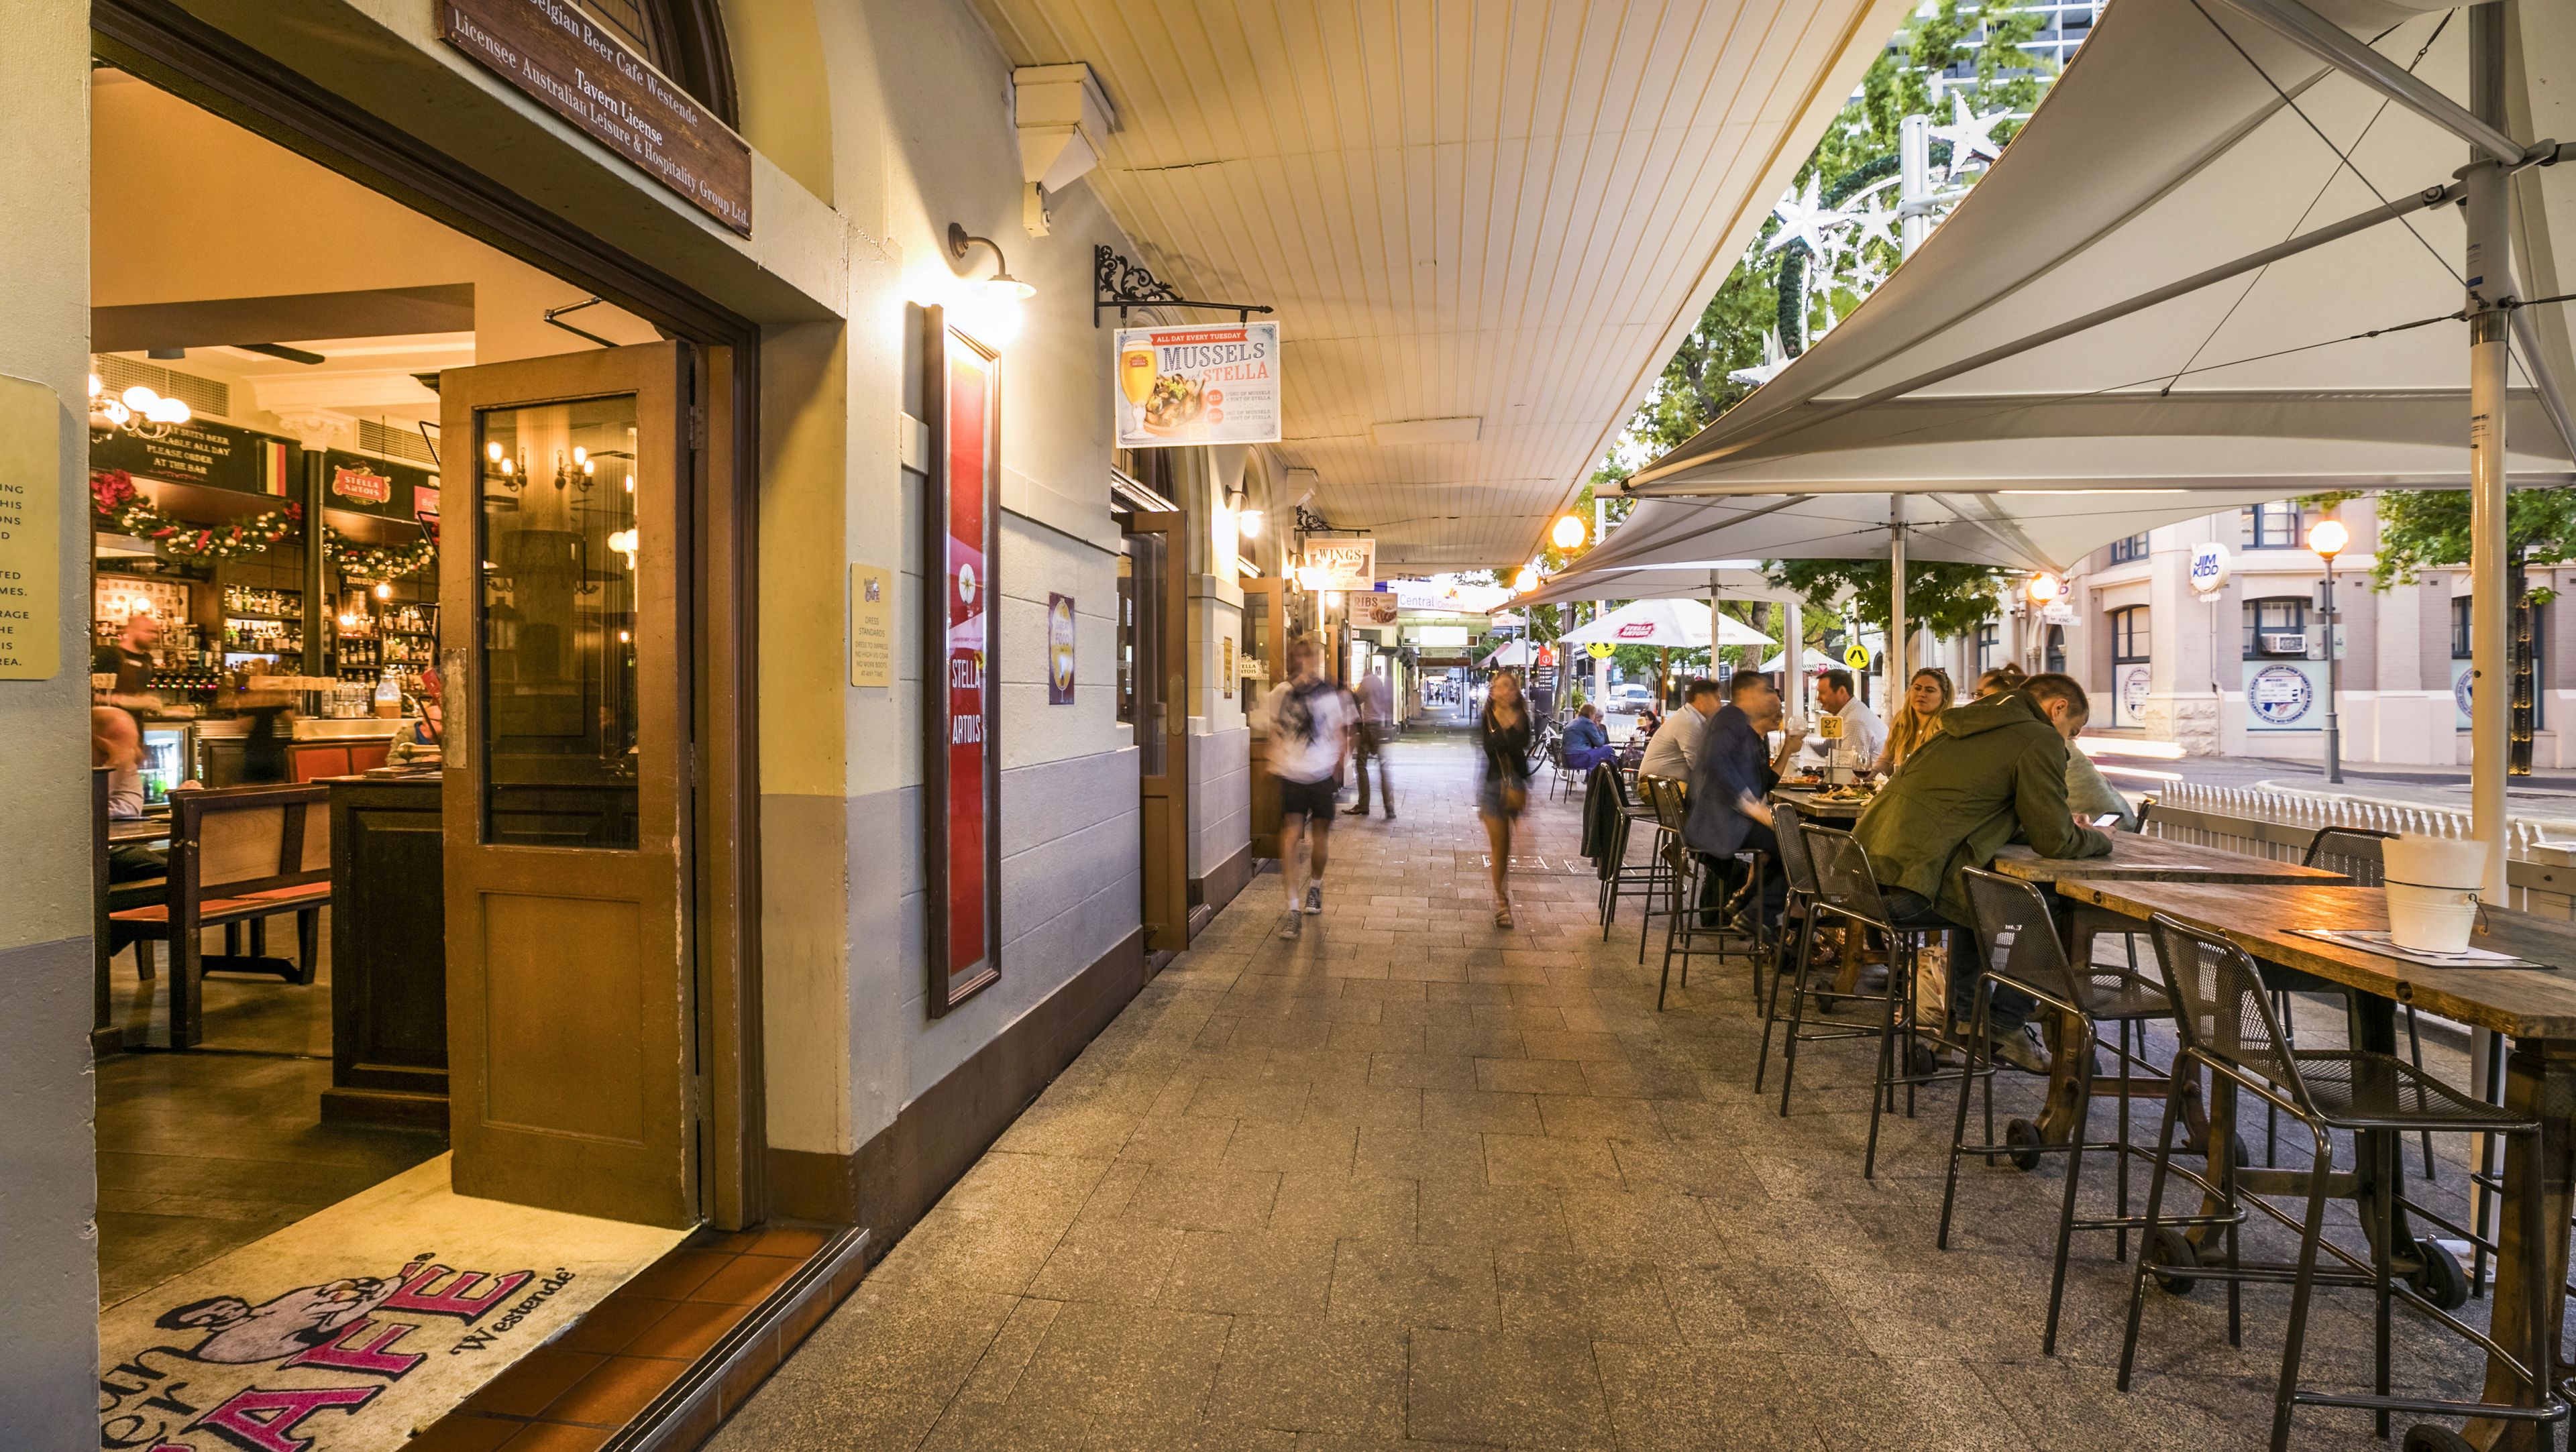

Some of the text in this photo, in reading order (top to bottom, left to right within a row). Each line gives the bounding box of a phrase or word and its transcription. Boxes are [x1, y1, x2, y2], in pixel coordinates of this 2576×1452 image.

[530, 0, 698, 127] elgian Beer Cafe Westende
[575, 67, 663, 146] Tavern License
[455, 9, 749, 227] Licensee Australian Leisure & Hospitality Group Ltd.
[1163, 343, 1265, 372] MUSSELS
[1187, 361, 1269, 382] and STELLA
[207, 435, 230, 445] BEER
[146, 445, 213, 464] PLEASE ORDER
[193, 443, 211, 453] ALL
[211, 446, 231, 456] DAY
[154, 458, 208, 475] AT THE BAR
[344, 476, 379, 488] STELLA
[344, 484, 380, 496] ARTOIS
[0, 516, 21, 525] NS
[1319, 549, 1361, 560] WINGS
[2195, 553, 2216, 567] JIM
[2192, 565, 2218, 577] KIDD
[1354, 596, 1378, 607] RIBS
[1399, 594, 1434, 607] Central
[865, 616, 879, 625] DRESS
[859, 627, 885, 637] STANDARDS
[855, 640, 867, 649] DRESS
[1055, 632, 1069, 645] FOOD
[1, 642, 13, 650] IS
[0, 658, 22, 666] EA.
[952, 659, 980, 688] STELLA
[952, 714, 980, 744] ARTOIS
[1824, 719, 1838, 728] 27
